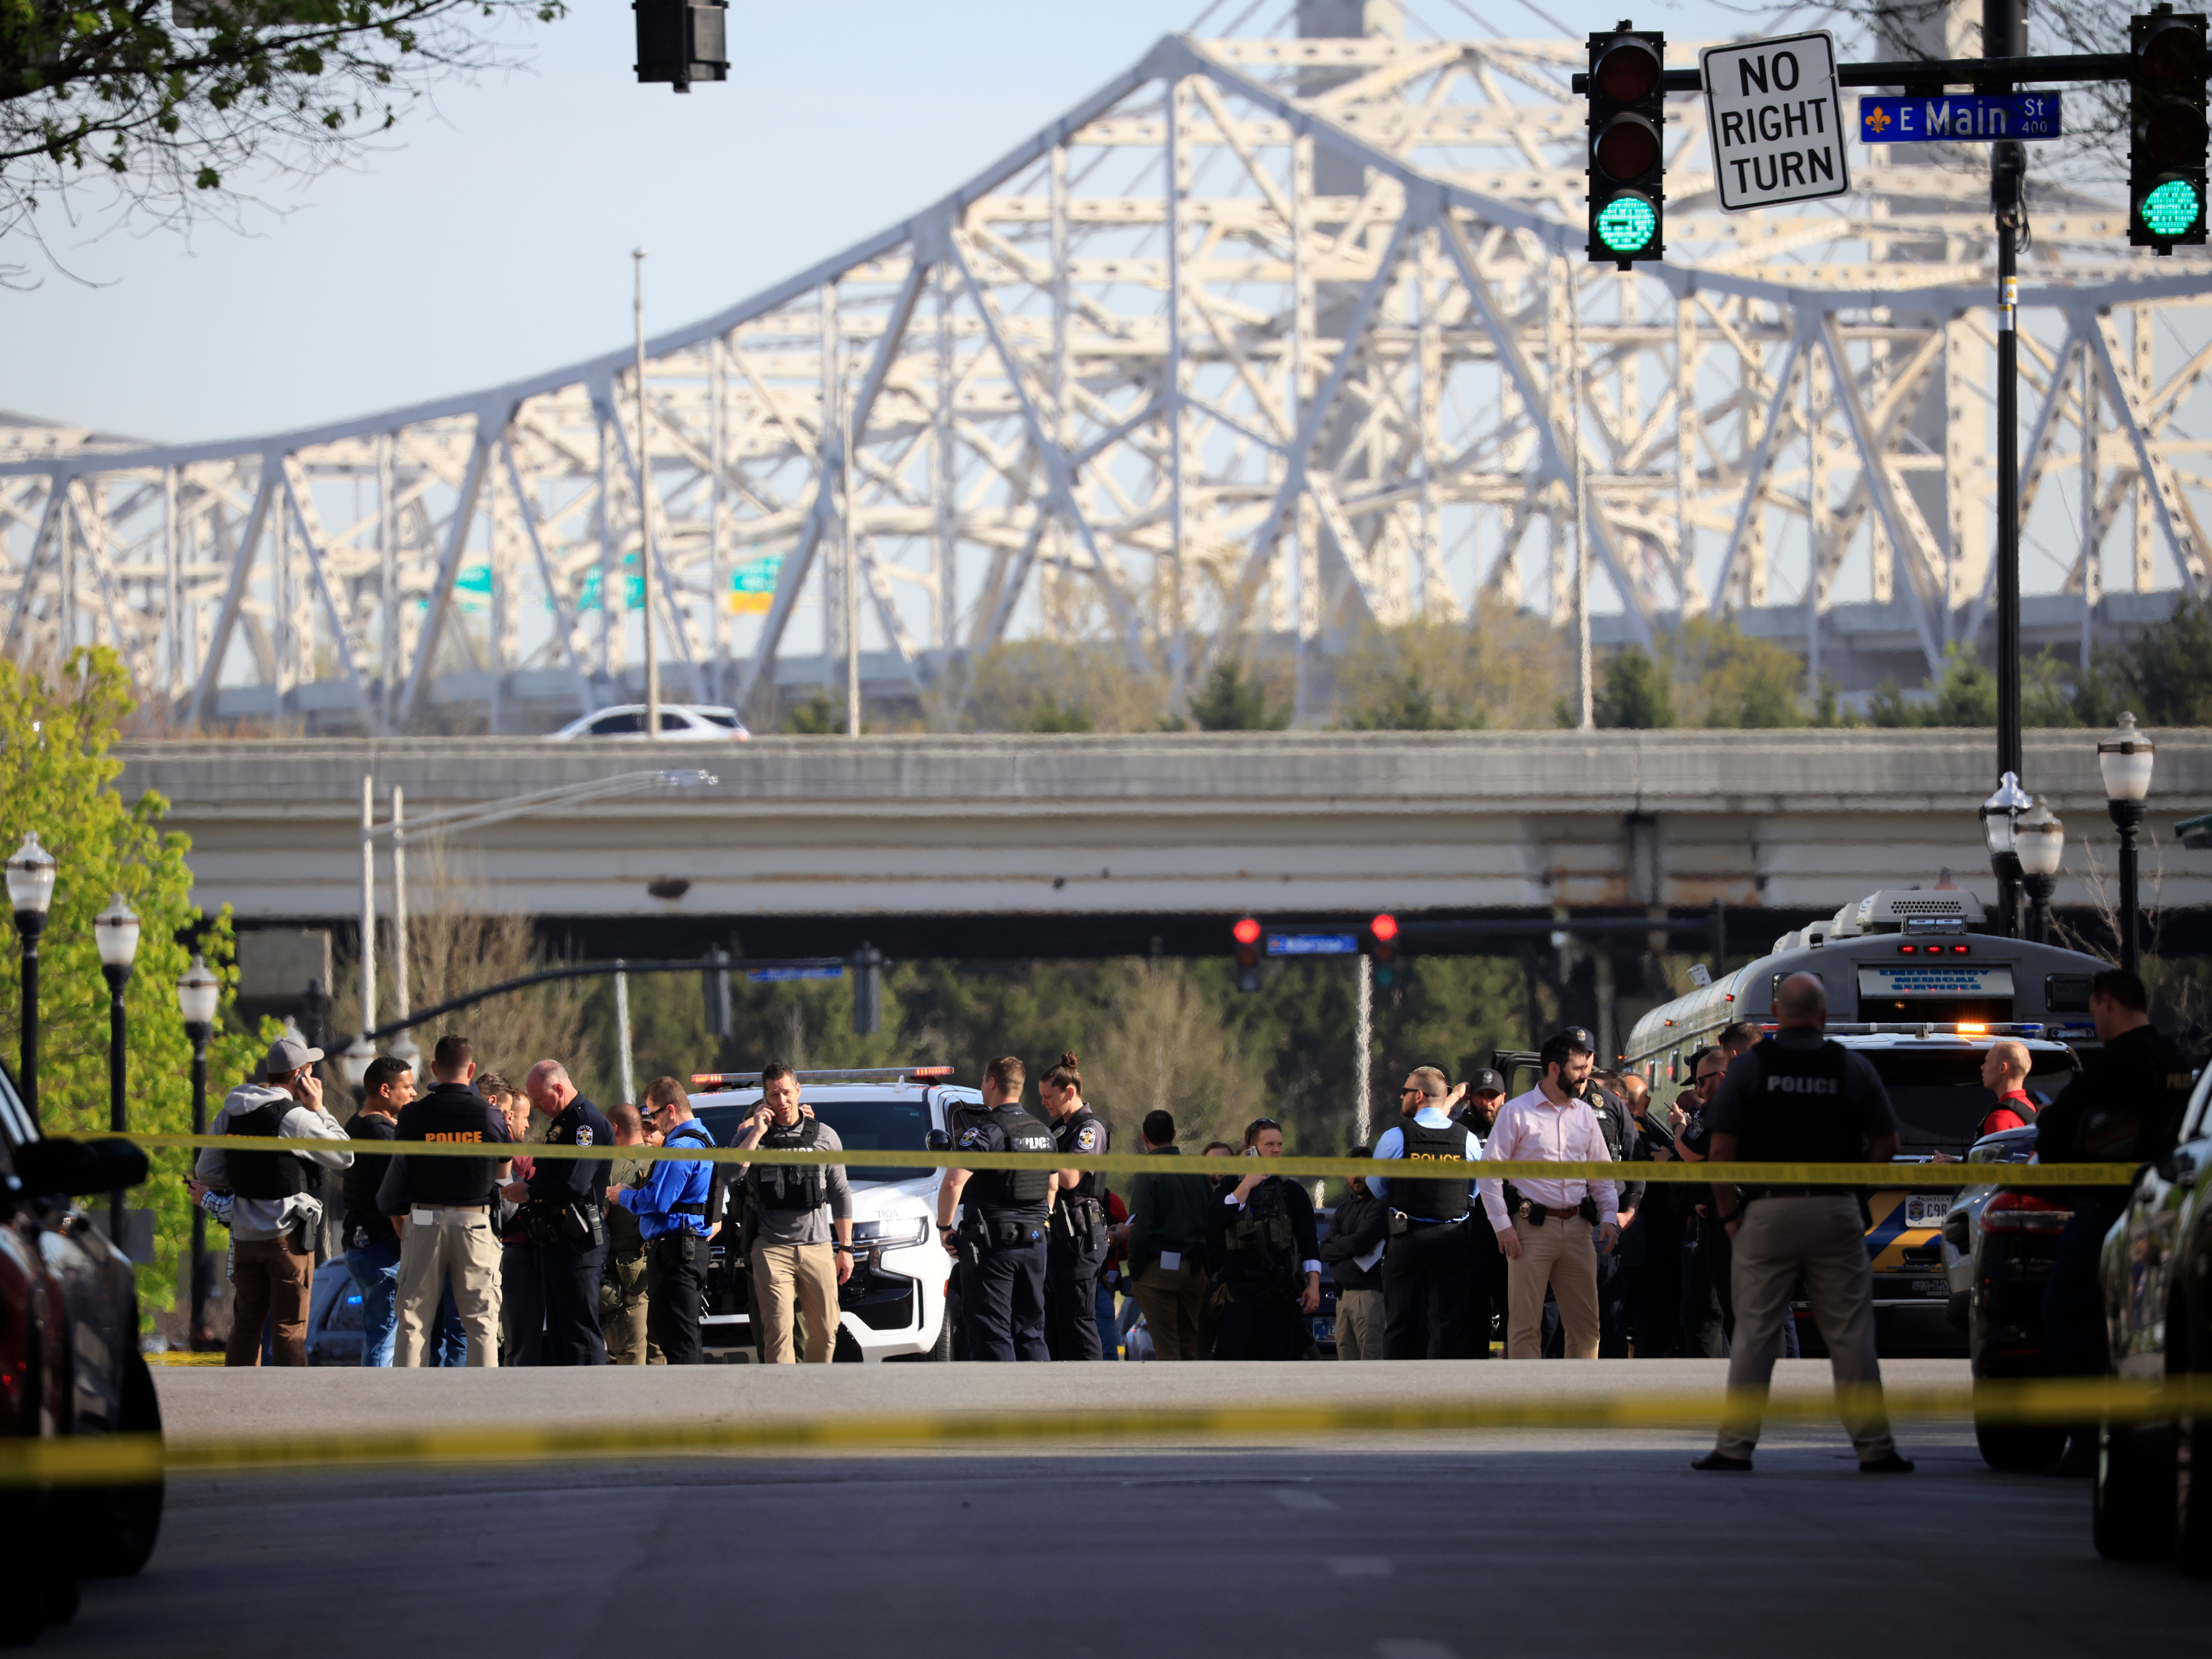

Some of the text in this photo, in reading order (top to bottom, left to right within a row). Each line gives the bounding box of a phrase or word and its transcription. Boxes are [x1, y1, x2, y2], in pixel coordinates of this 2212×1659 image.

[1738, 51, 1799, 97] NO
[1721, 98, 1827, 147] RIGHT
[1901, 98, 2044, 136] E Main St
[2021, 121, 2048, 134] 400
[1729, 146, 1833, 194] TURN
[1767, 1075, 1838, 1094] POLICE
[425, 1131, 483, 1144] POLICE
[875, 1209, 899, 1219] 7824
